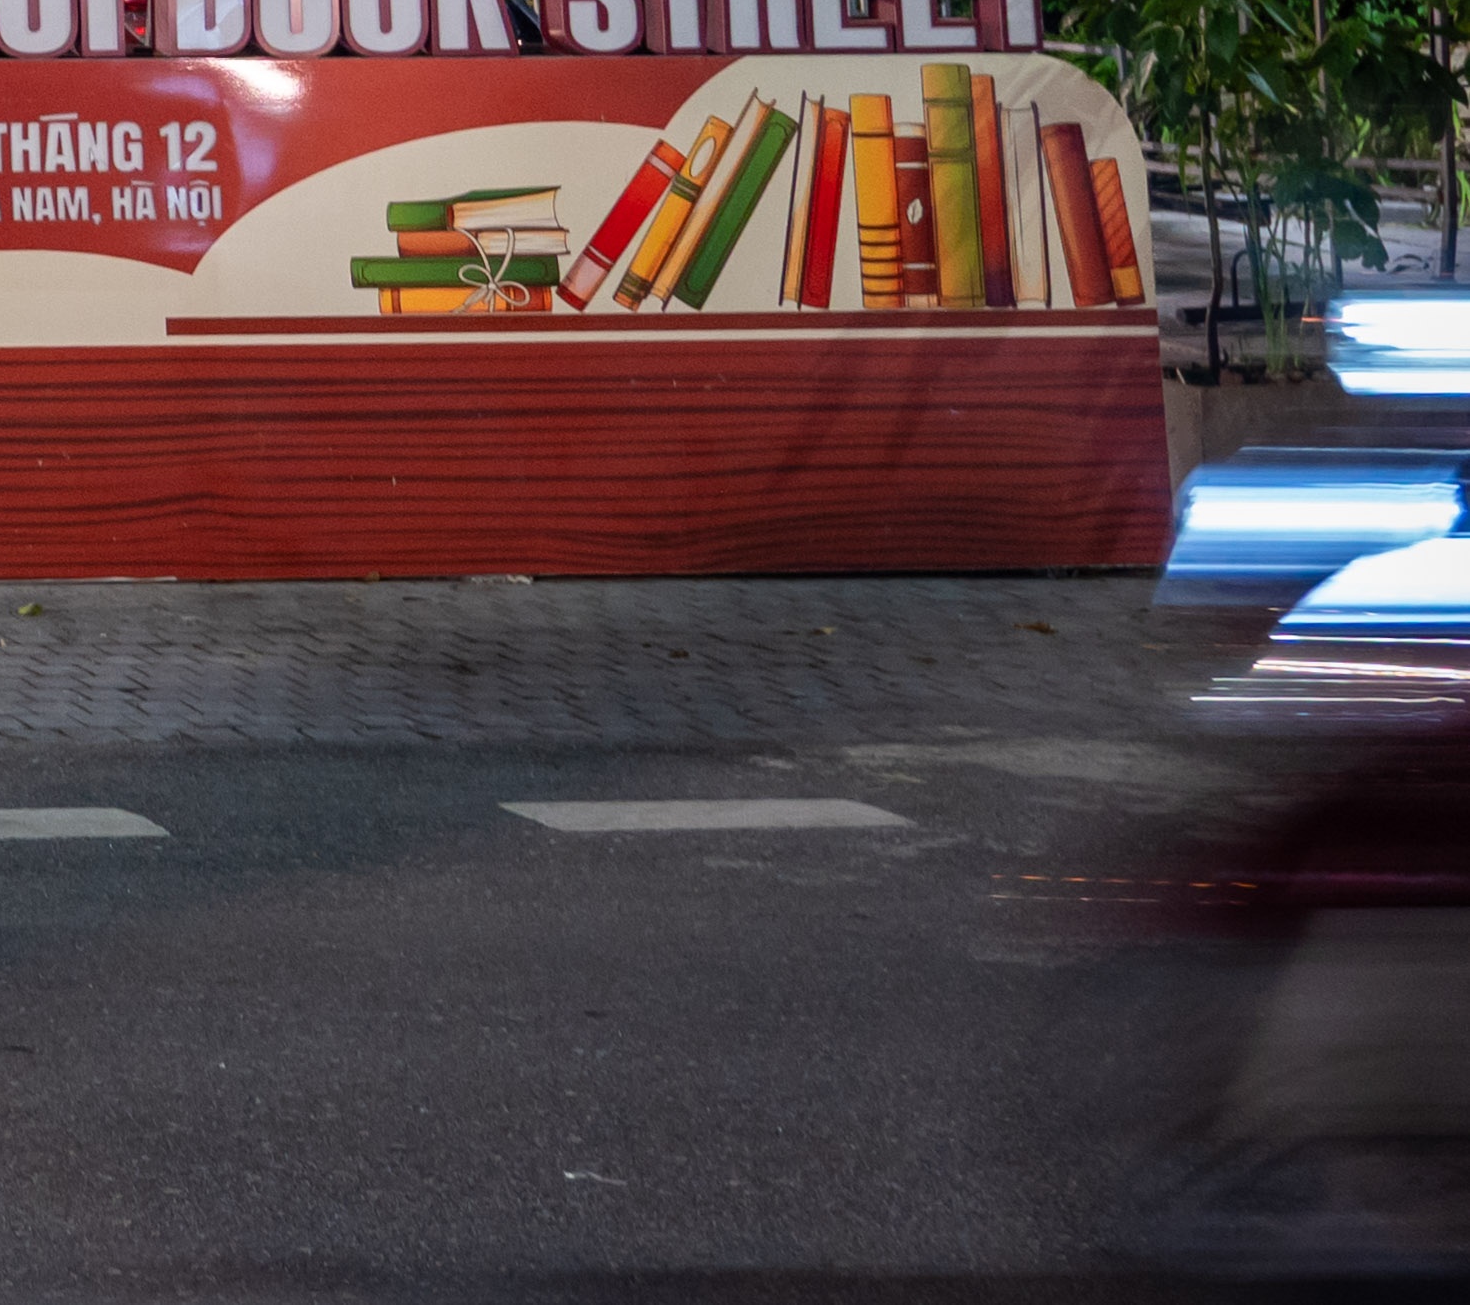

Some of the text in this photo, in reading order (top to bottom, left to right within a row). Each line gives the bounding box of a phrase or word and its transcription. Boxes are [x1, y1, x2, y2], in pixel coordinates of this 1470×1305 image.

[159, 122, 218, 173] 12
[12, 187, 102, 225] NAM,
[112, 179, 156, 221] HÀ
[166, 179, 223, 227] NỘI
